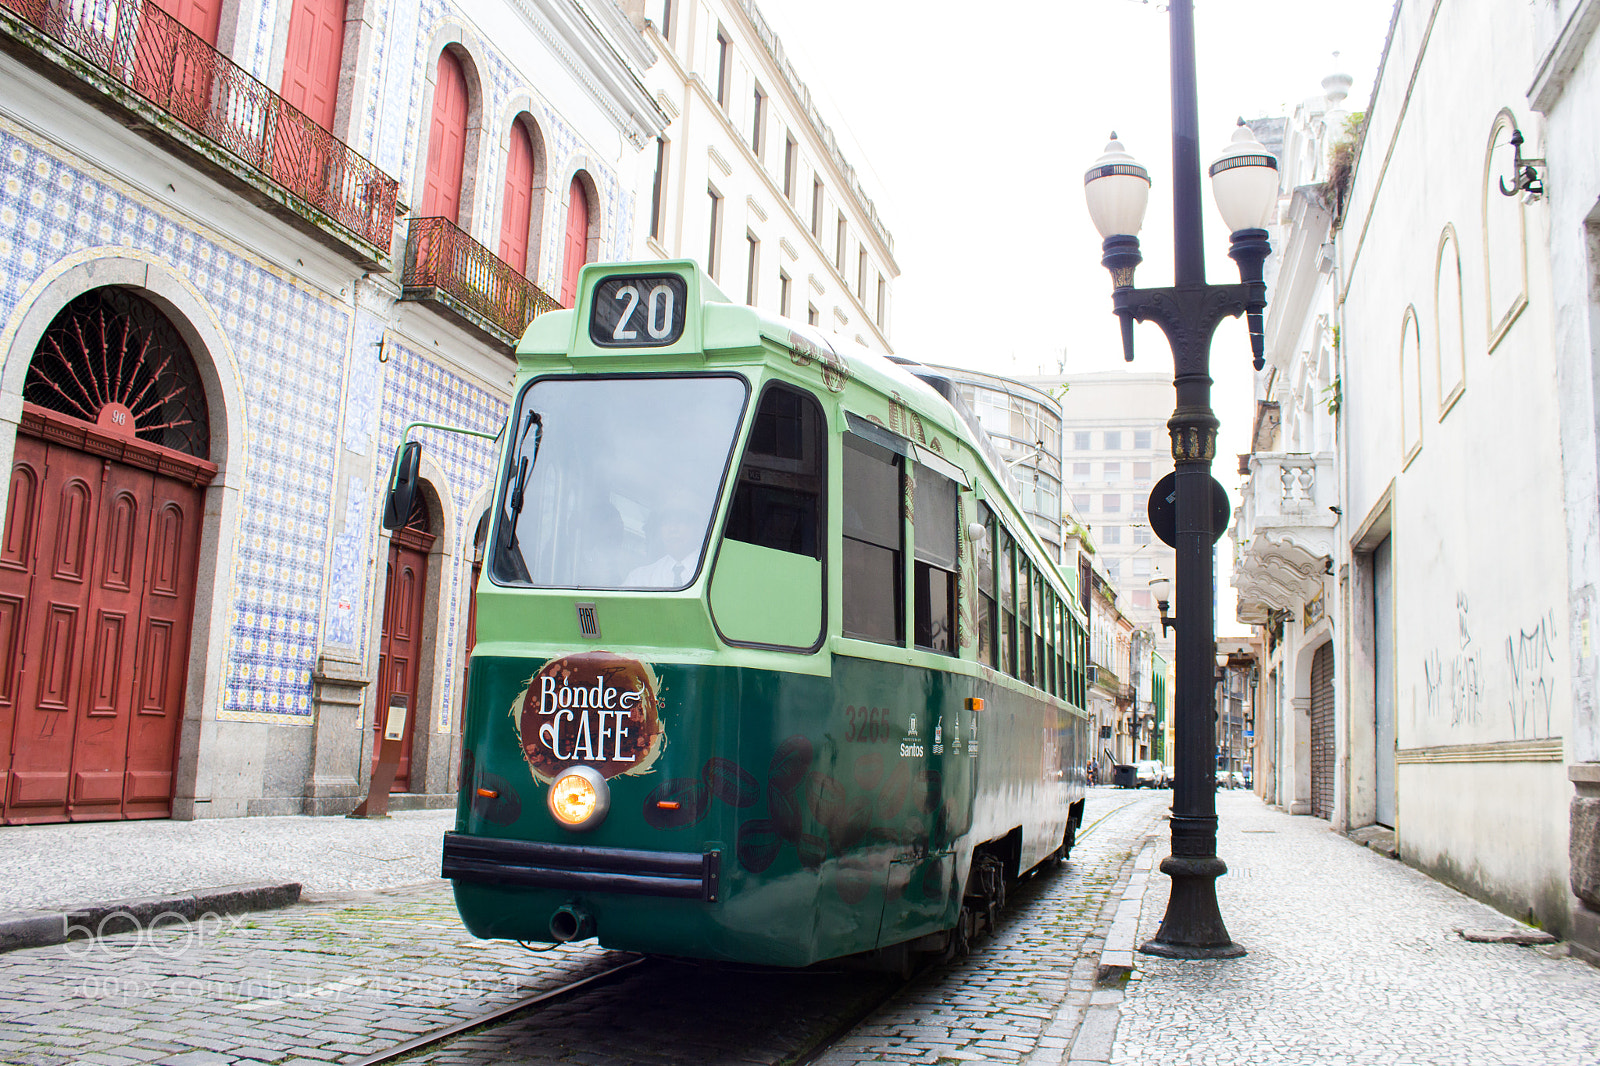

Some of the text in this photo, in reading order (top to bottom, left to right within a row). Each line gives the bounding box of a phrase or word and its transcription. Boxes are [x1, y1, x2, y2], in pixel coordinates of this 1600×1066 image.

[612, 285, 674, 340] 20
[112, 410, 126, 426] 96
[578, 607, 597, 635] FIAT
[845, 705, 890, 744] 3265
[900, 742, 924, 758] Santos
